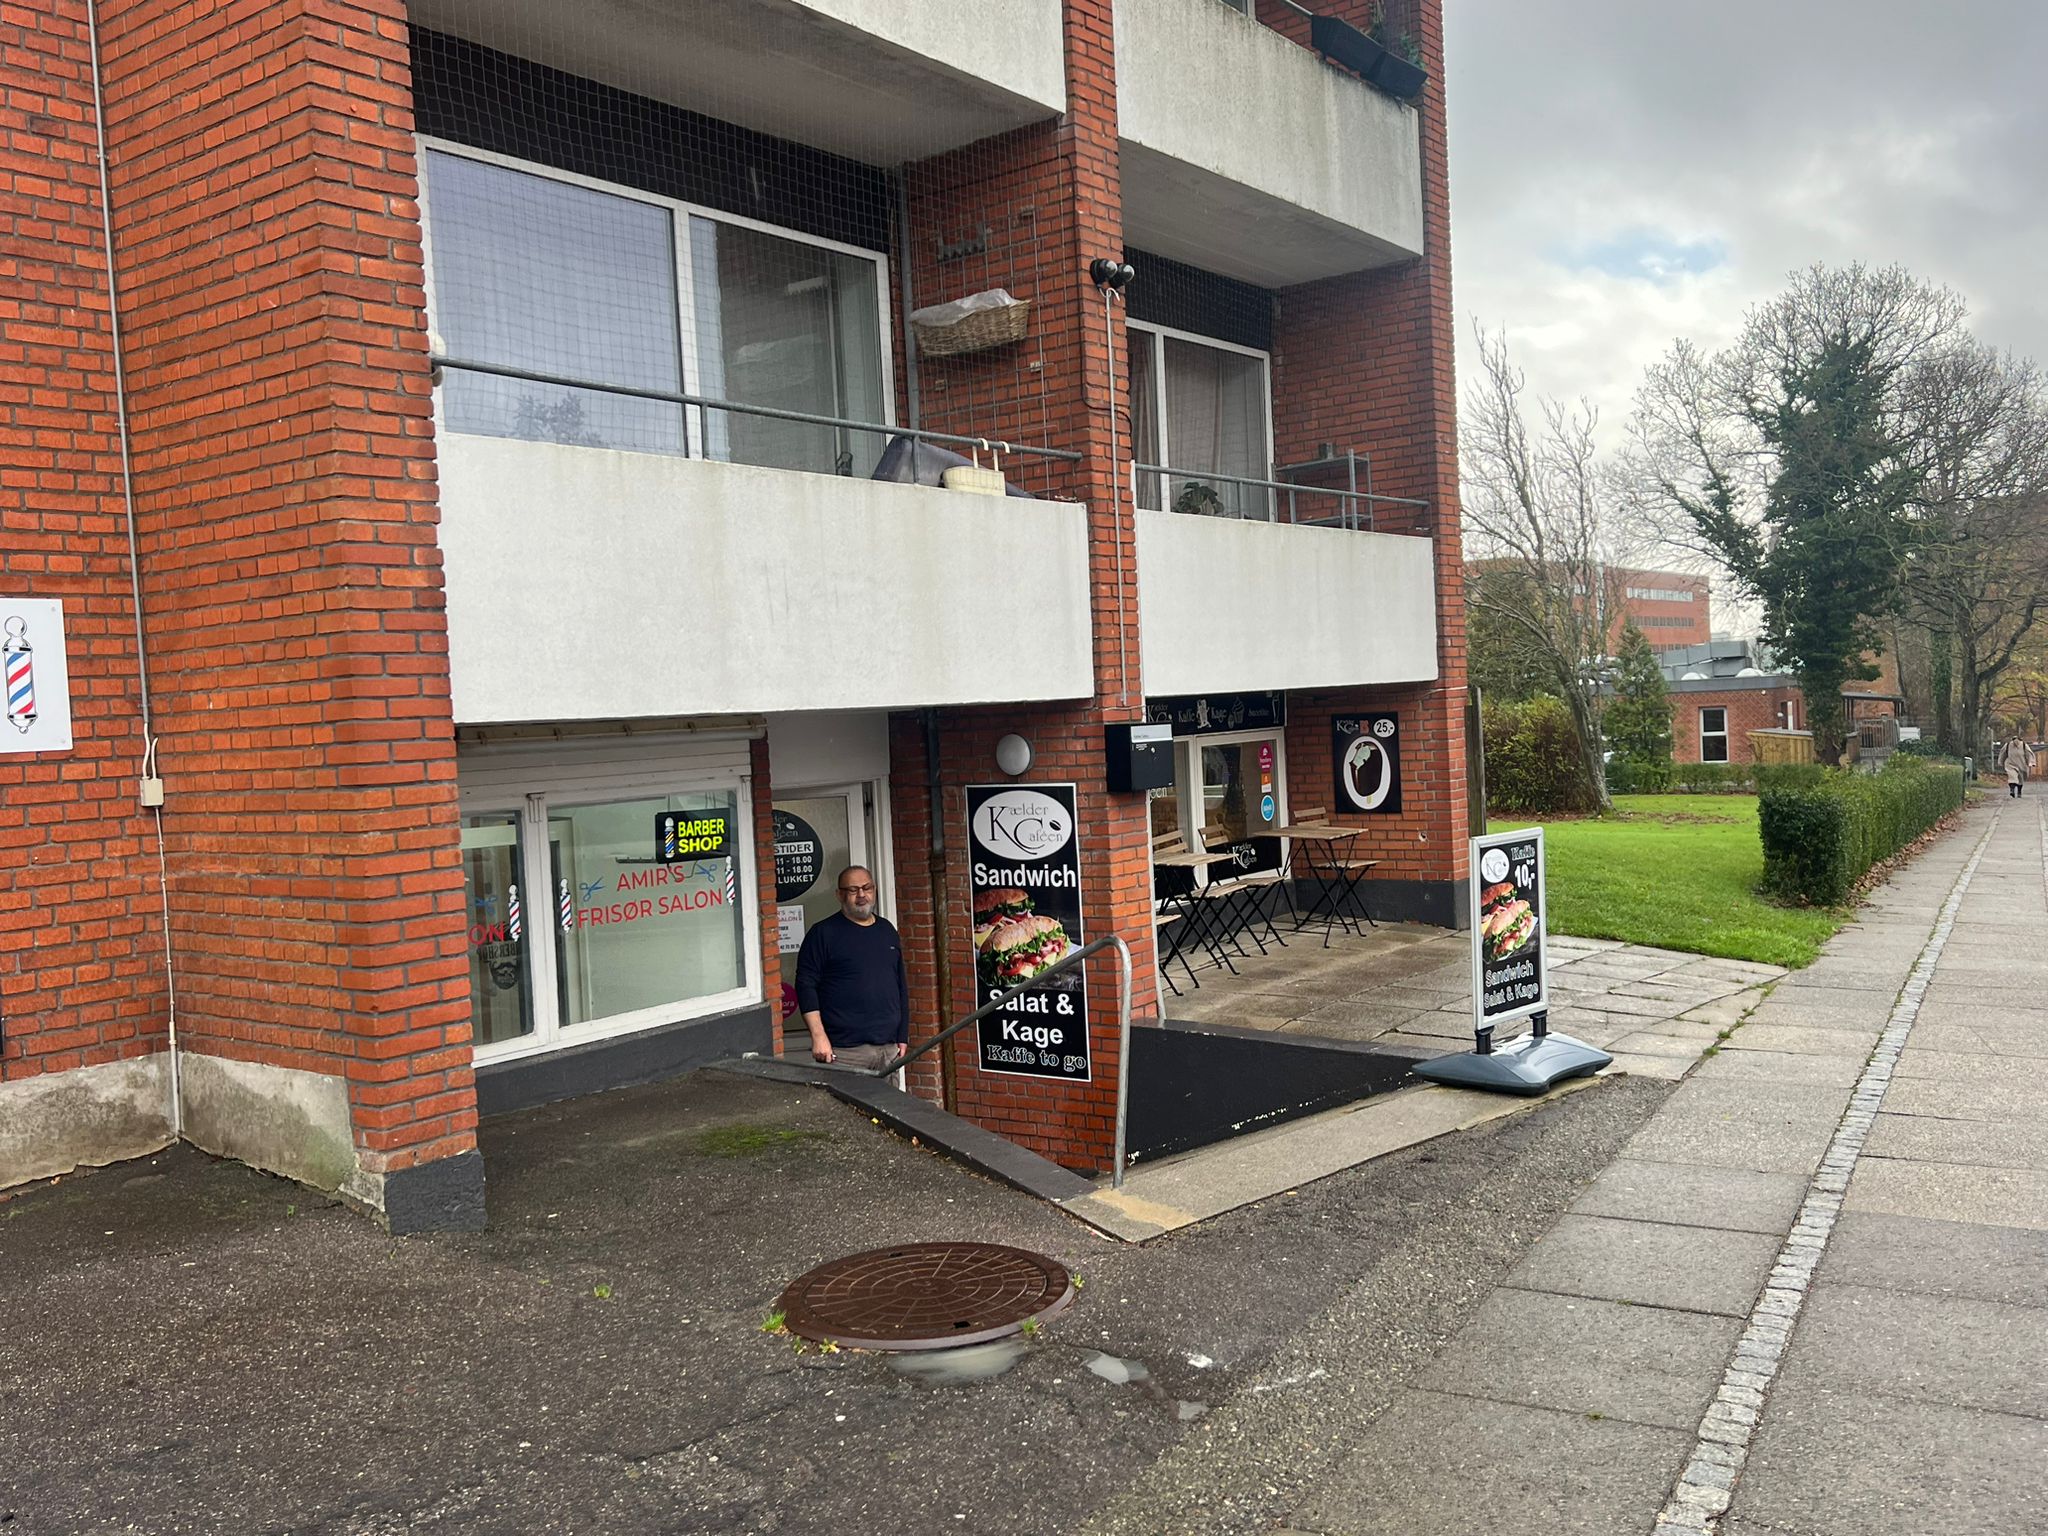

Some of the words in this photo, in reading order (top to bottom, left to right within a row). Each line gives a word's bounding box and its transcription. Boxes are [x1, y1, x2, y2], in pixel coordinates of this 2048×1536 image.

[678, 818, 725, 838] BARBER
[678, 836, 723, 853] SHOP
[773, 843, 811, 854] STIDER
[616, 865, 686, 892] AMIR'S
[778, 874, 815, 884] LUKKET
[974, 862, 1077, 888] Sandwich
[577, 900, 653, 929] FRISØR
[658, 888, 722, 916] SALON
[468, 921, 506, 945] ON
[1485, 959, 1534, 988] Sandwich
[989, 989, 1049, 1013] Salat
[1056, 993, 1074, 1015] &
[1506, 985, 1515, 1002] &
[1002, 1019, 1063, 1048] Kage
[986, 1044, 1035, 1064] Kaffe
[1039, 1050, 1059, 1067] to
[1063, 1055, 1087, 1072] go
